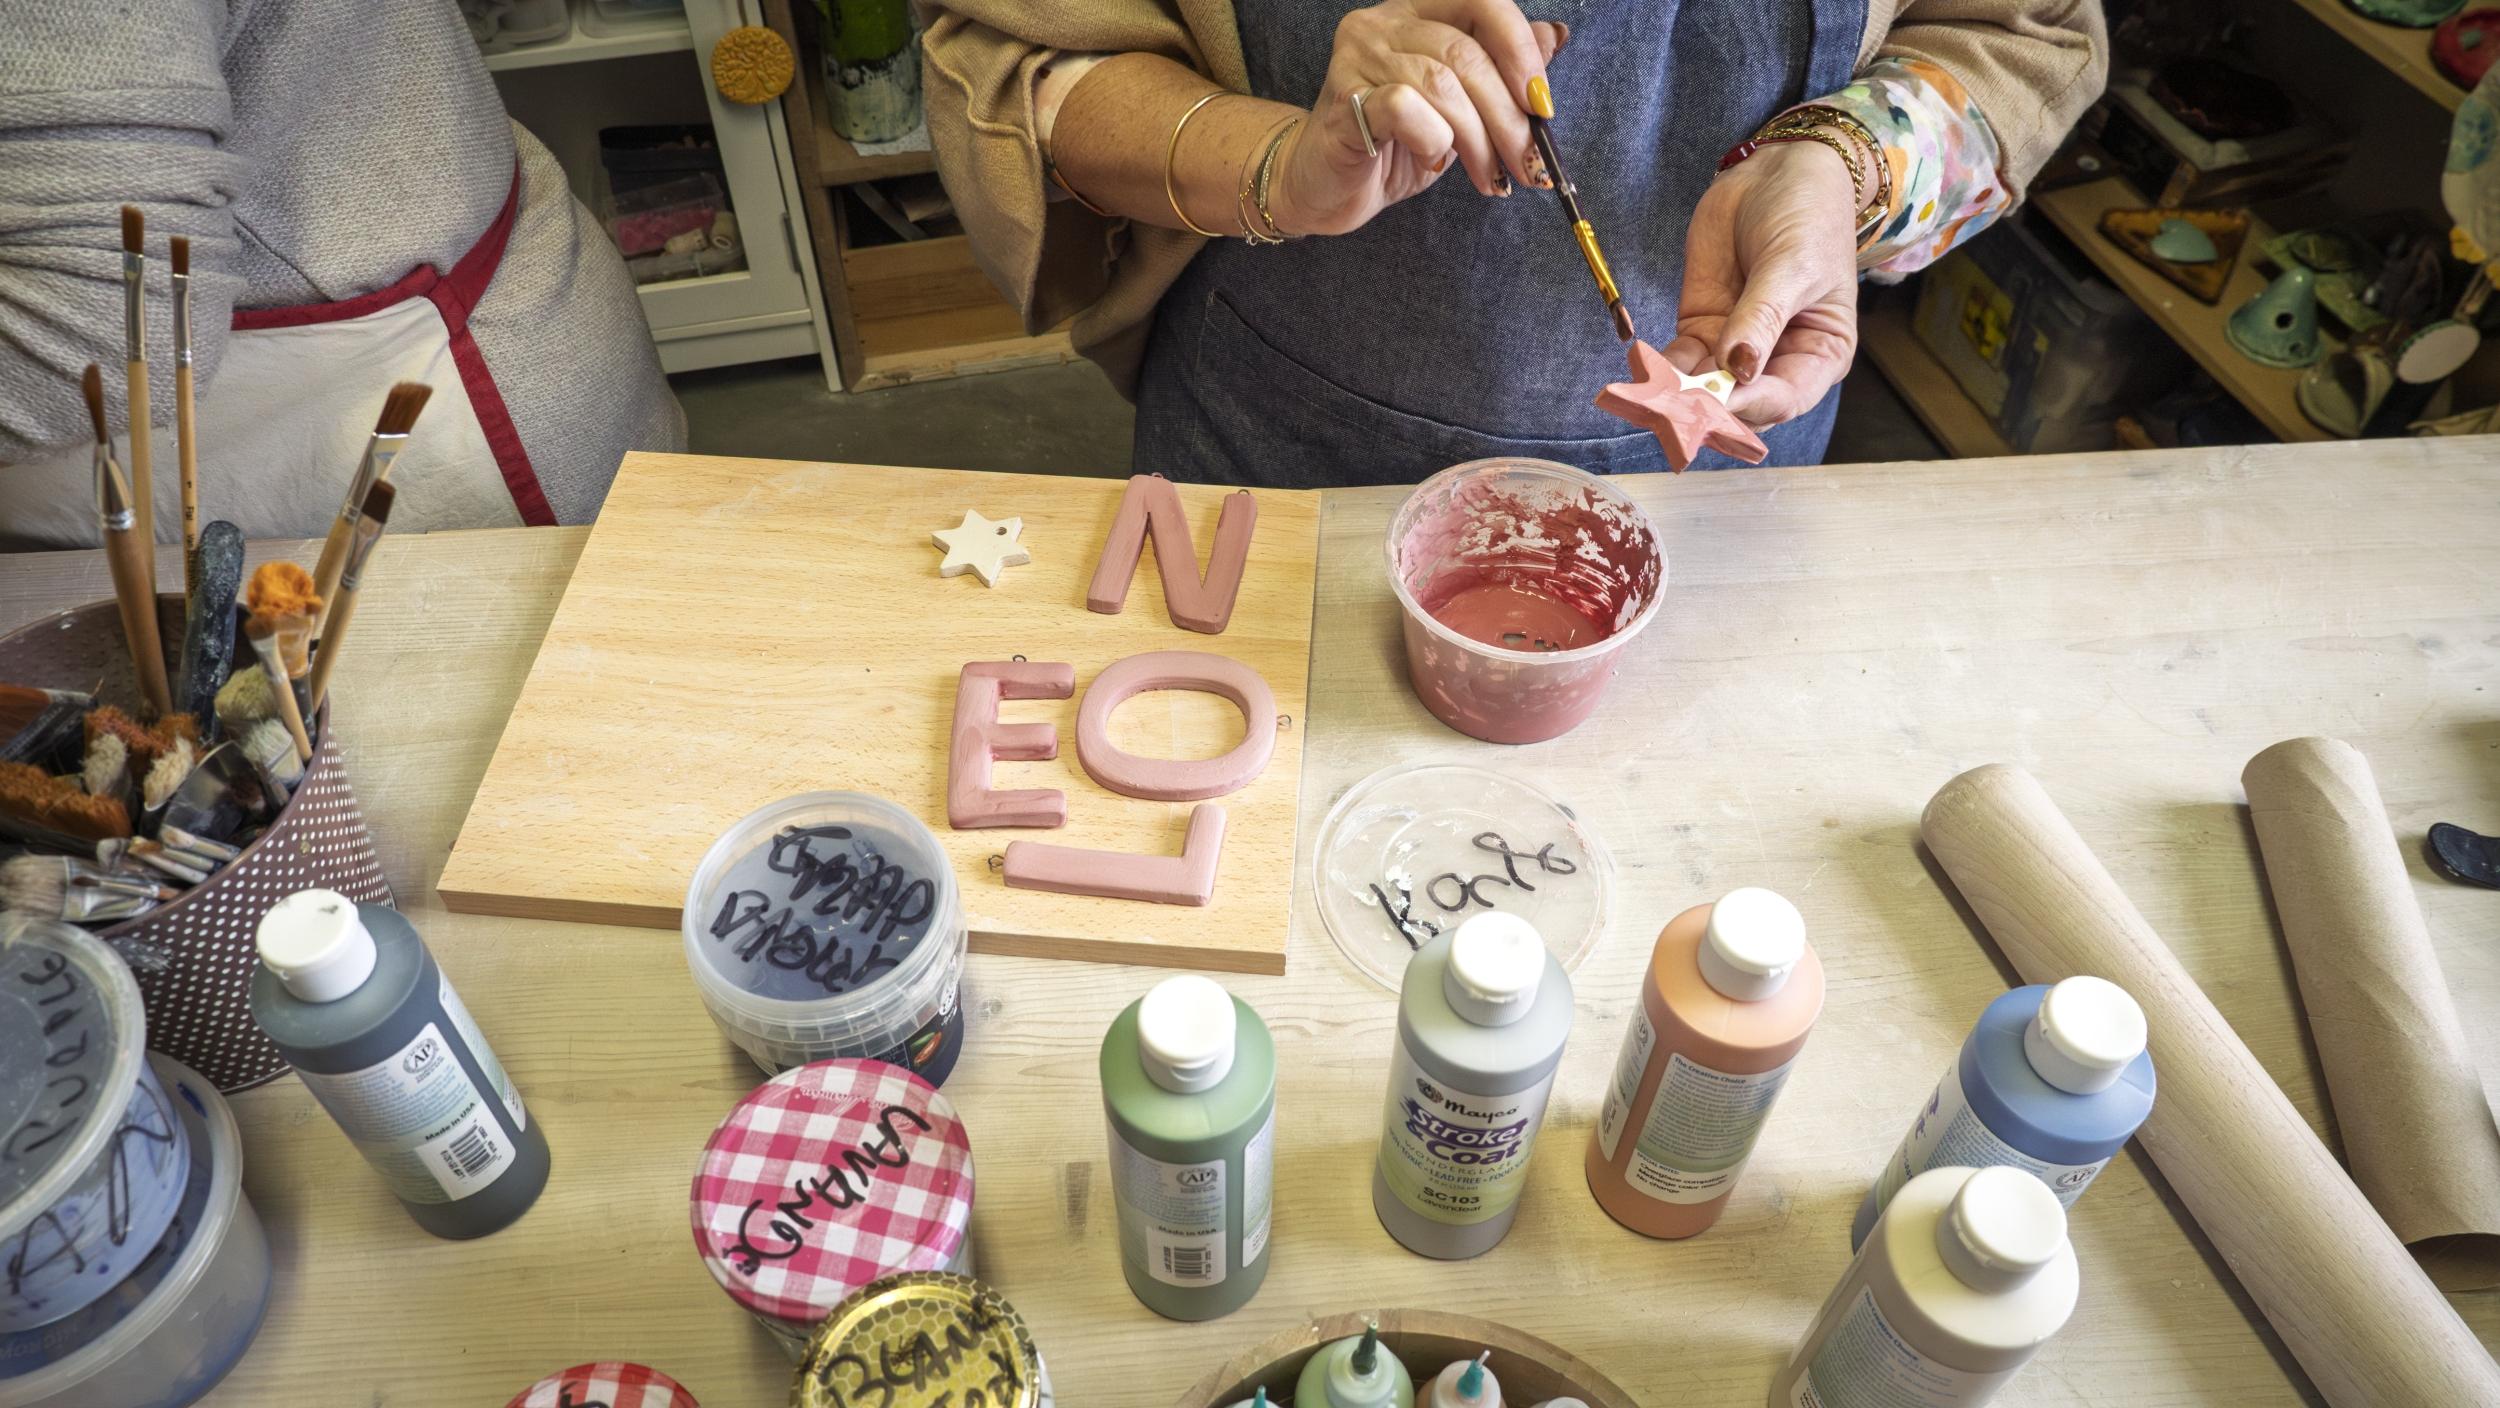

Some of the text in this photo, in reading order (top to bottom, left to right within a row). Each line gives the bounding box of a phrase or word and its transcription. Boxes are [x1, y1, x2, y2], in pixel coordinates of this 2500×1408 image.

[425, 1126, 451, 1142] Made
[460, 1102, 476, 1120] USA
[1445, 1099, 1518, 1124] Mayco
[1412, 1107, 1518, 1145] Stroke
[1426, 1140, 1522, 1165] Coat
[1423, 1185, 1481, 1205] SC103
